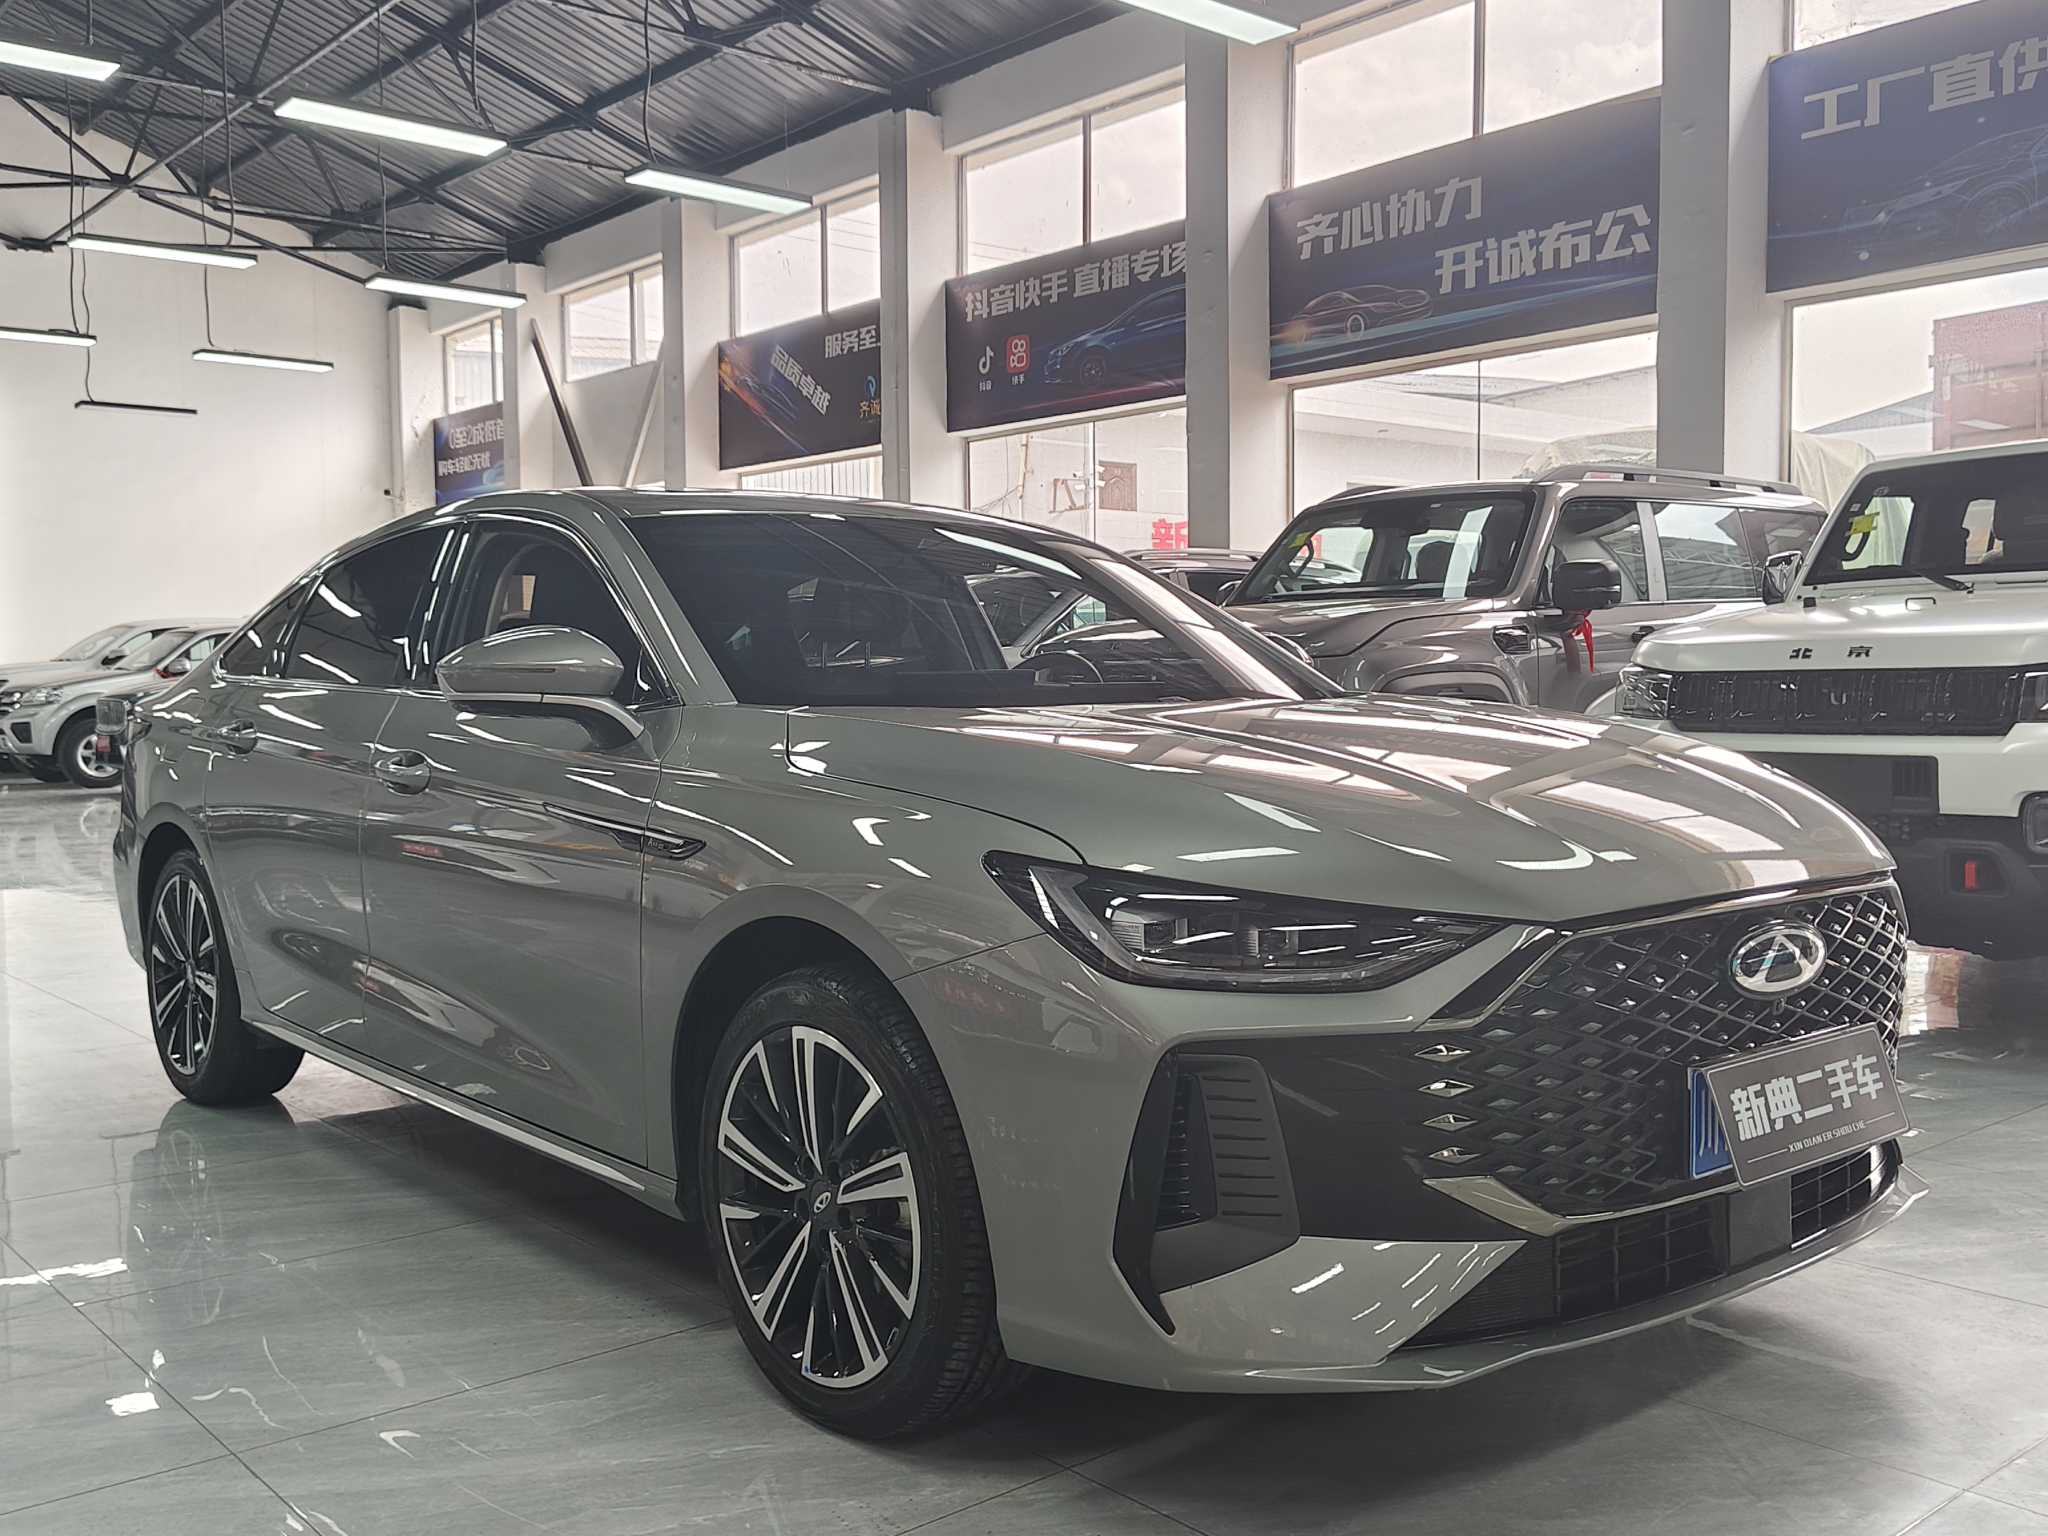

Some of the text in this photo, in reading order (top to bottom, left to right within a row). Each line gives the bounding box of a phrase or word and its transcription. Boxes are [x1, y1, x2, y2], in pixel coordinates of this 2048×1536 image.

[1801, 35, 2048, 140] 工厂直供
[1296, 176, 1483, 260] 齐心协力
[1434, 204, 1652, 294] 开诚布公
[771, 344, 831, 415] 品质卓越
[824, 325, 880, 358] 服务至
[1730, 1054, 1884, 1142] 新典二手车
[1788, 1142, 1803, 1153] XIN
[1822, 1130, 1833, 1142] ER
[1832, 1123, 1853, 1138] SHOU
